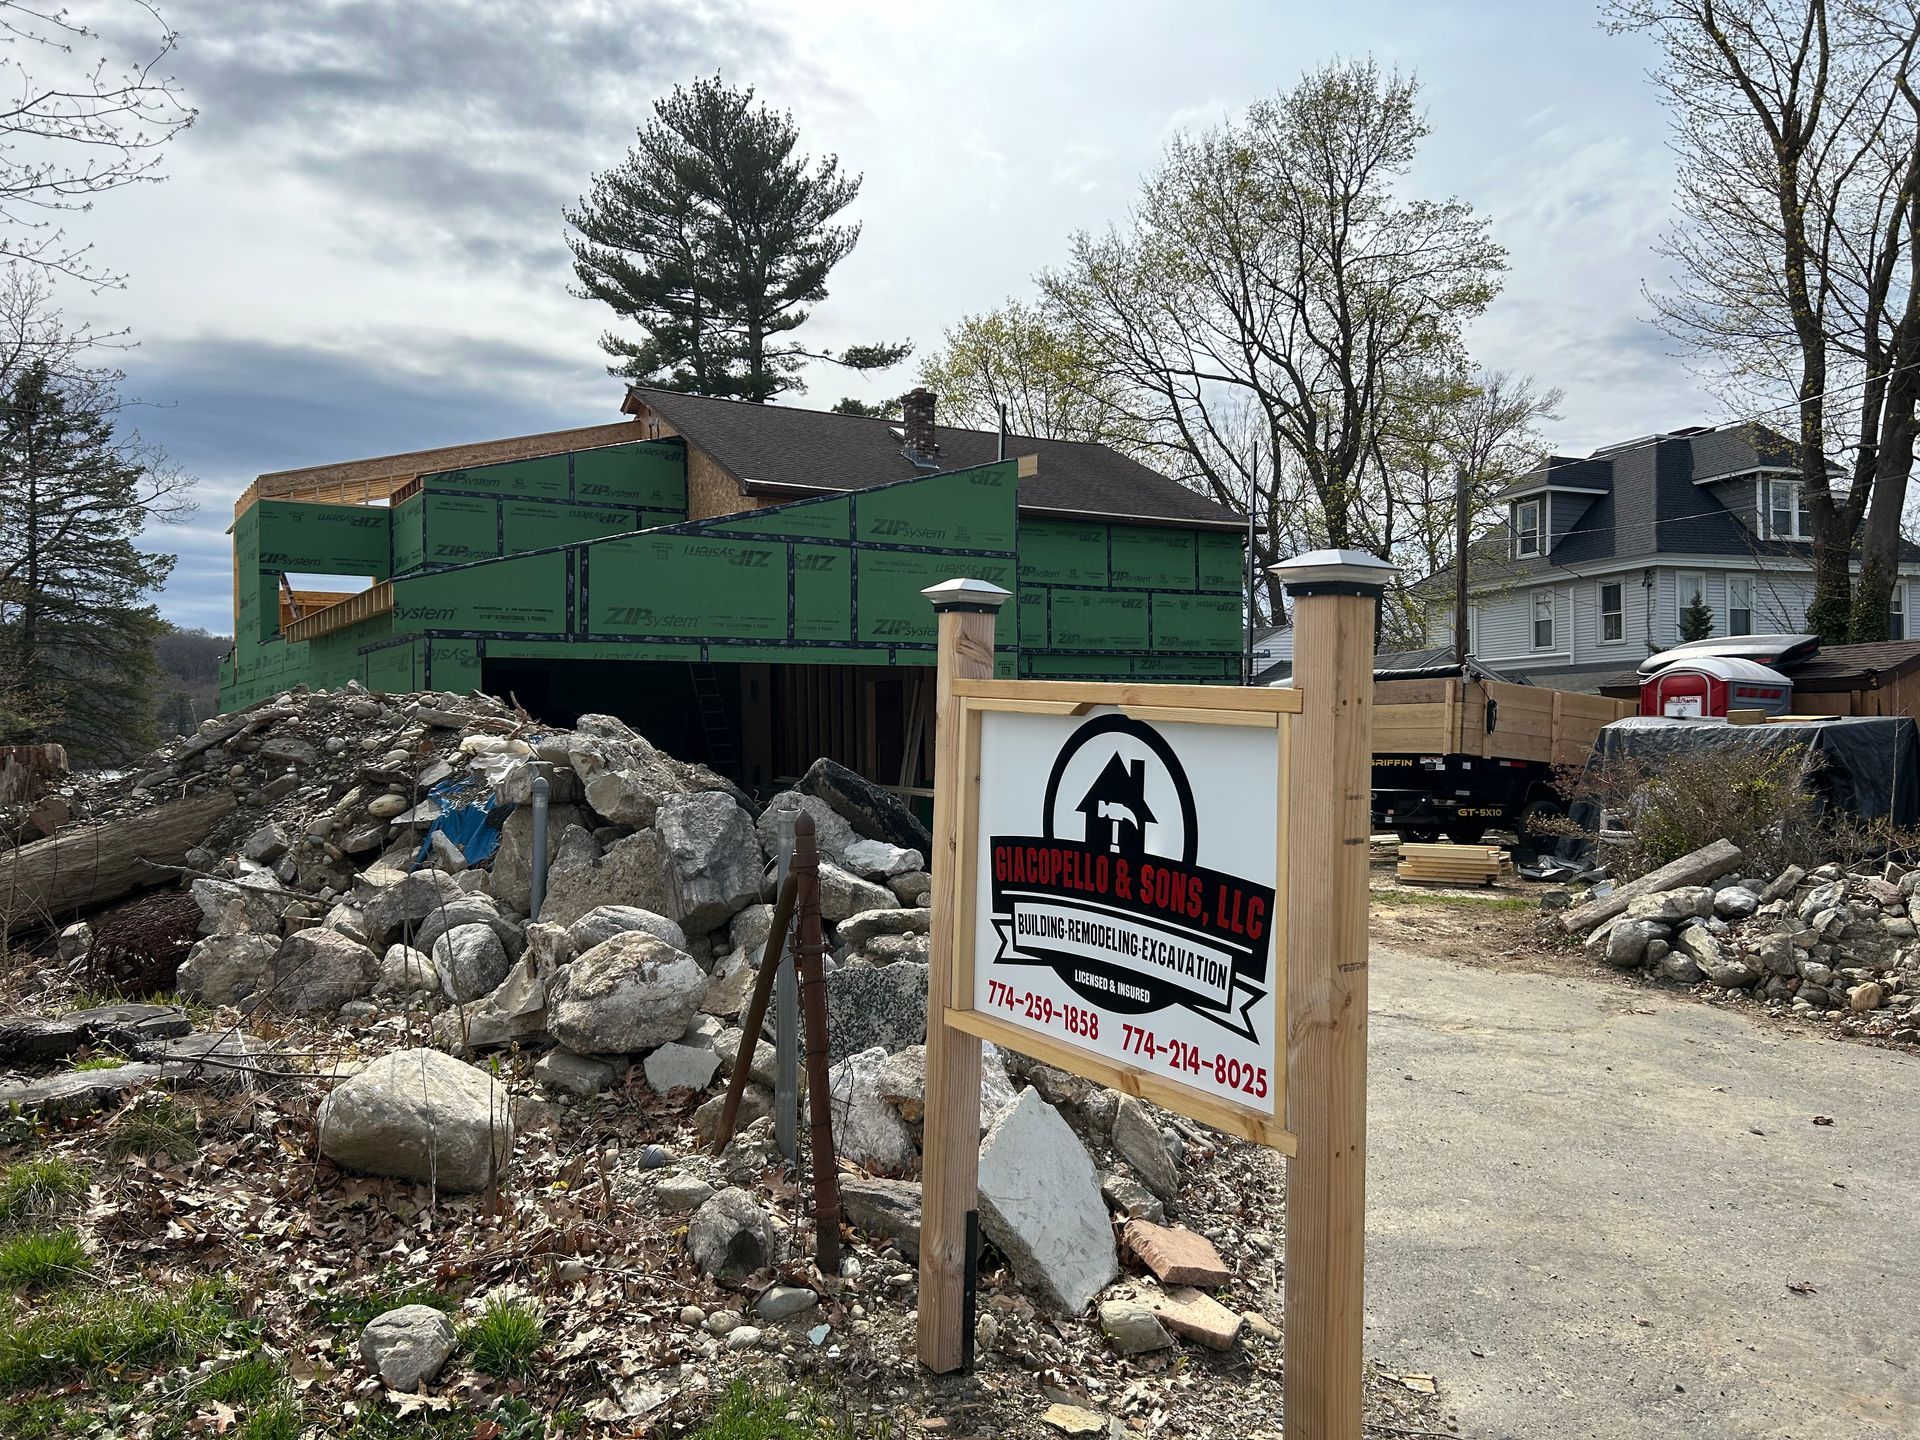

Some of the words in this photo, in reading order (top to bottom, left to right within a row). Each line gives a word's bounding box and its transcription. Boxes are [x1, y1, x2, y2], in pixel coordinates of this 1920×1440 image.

[995, 847, 1109, 893] GIACOPELLO
[1115, 858, 1132, 900] &
[1140, 864, 1209, 927] SONS,
[1217, 885, 1265, 940] LLC
[1075, 969, 1108, 991] LICENSED
[1109, 980, 1116, 994] &
[1117, 982, 1150, 1003] INSURED
[988, 979, 1099, 1040] 774-259-1858
[1122, 1023, 1268, 1098] 774-214-8025
